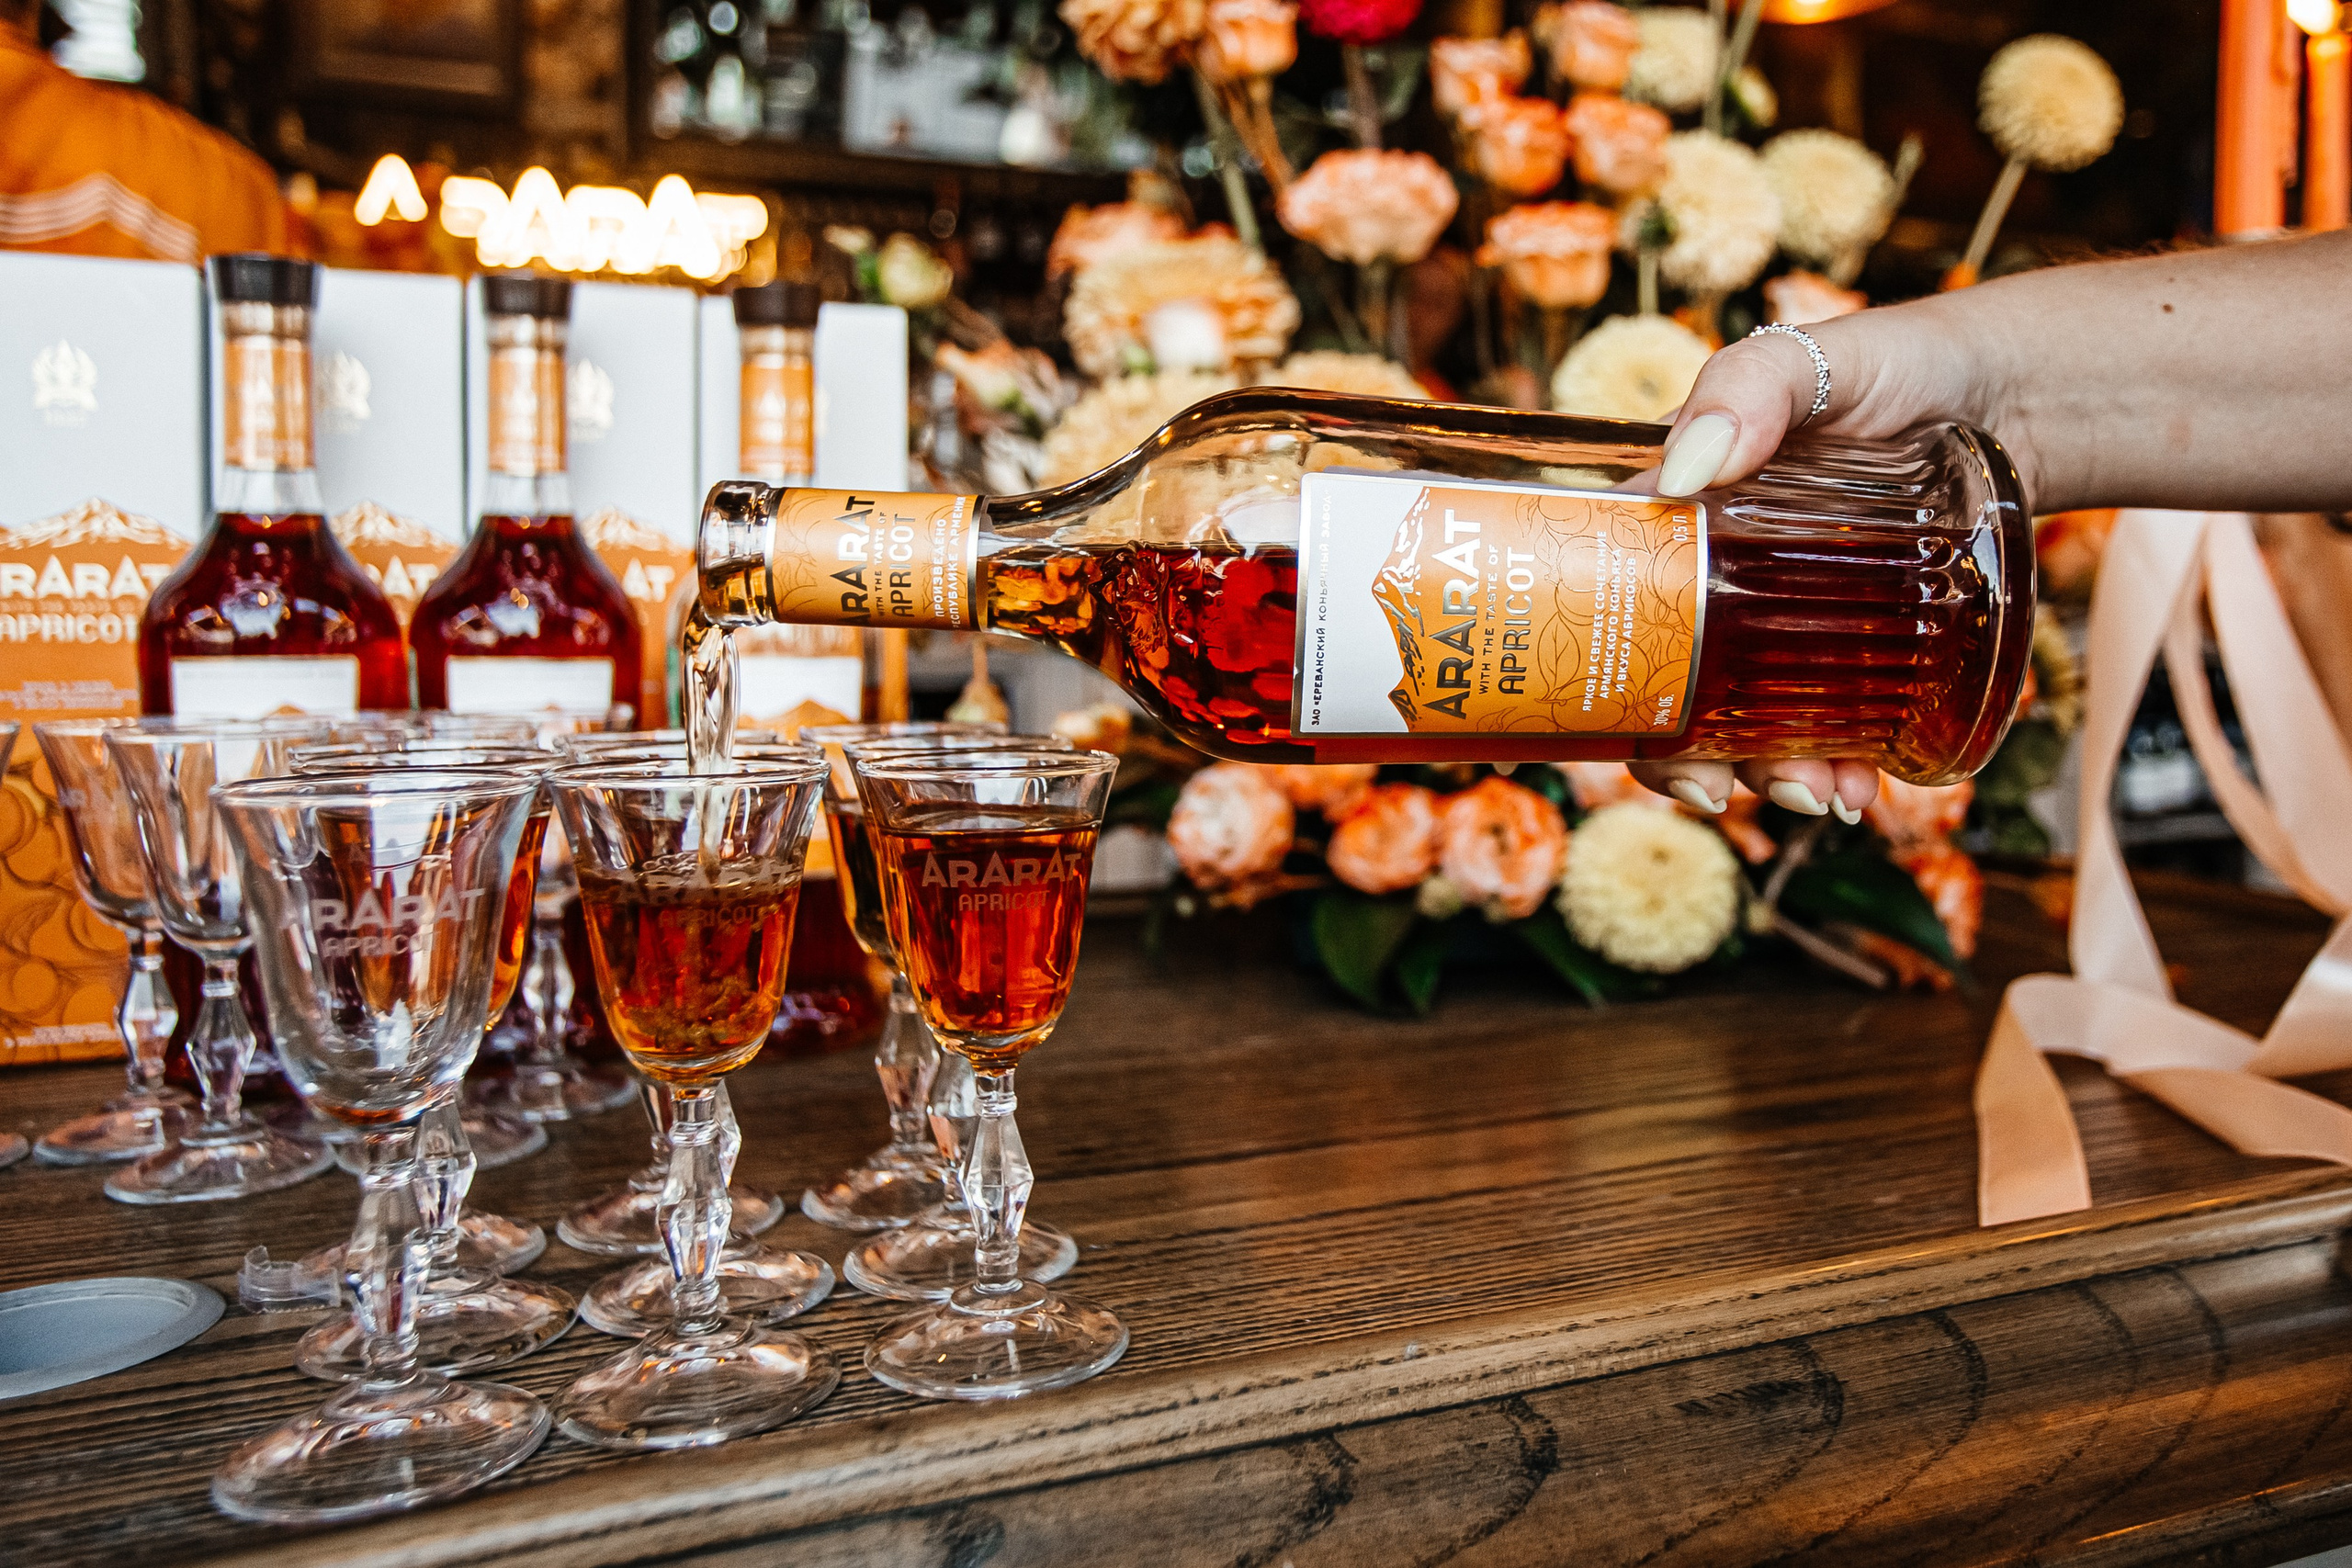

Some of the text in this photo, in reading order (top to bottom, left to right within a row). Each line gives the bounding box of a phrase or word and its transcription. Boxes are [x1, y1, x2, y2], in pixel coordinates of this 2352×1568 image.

[874, 528, 886, 565] TASTE
[877, 512, 887, 525] OF
[1672, 515, 1690, 542] 0,5 Л
[0, 553, 172, 600] RARAT
[875, 570, 883, 592] THE
[888, 513, 916, 617] APRICOT
[932, 518, 947, 617] ПРОИЗВЕДЕНО
[1318, 543, 1329, 622] КОНЬЯЧНЫЙ
[1421, 508, 1481, 720] ARARAT
[1478, 544, 1498, 695] WITH THE TASTE OF
[1498, 546, 1535, 694] APRICOT
[1582, 531, 1607, 712] ЯРКОЕ И СВЕЖЕЕ СОЧЕТАНИЕ
[1600, 548, 1622, 699] АРМЯНСКОГО КОНЬЯКА
[1615, 558, 1636, 693] И ВКУСА АБРИКОСОВ
[1313, 627, 1326, 705] «ЕРЕВАНСКИЙ
[1311, 708, 1321, 726] ЗАО
[1654, 708, 1671, 726] 30%
[922, 846, 1082, 888] ARARAT
[958, 889, 1050, 911] APRICOT
